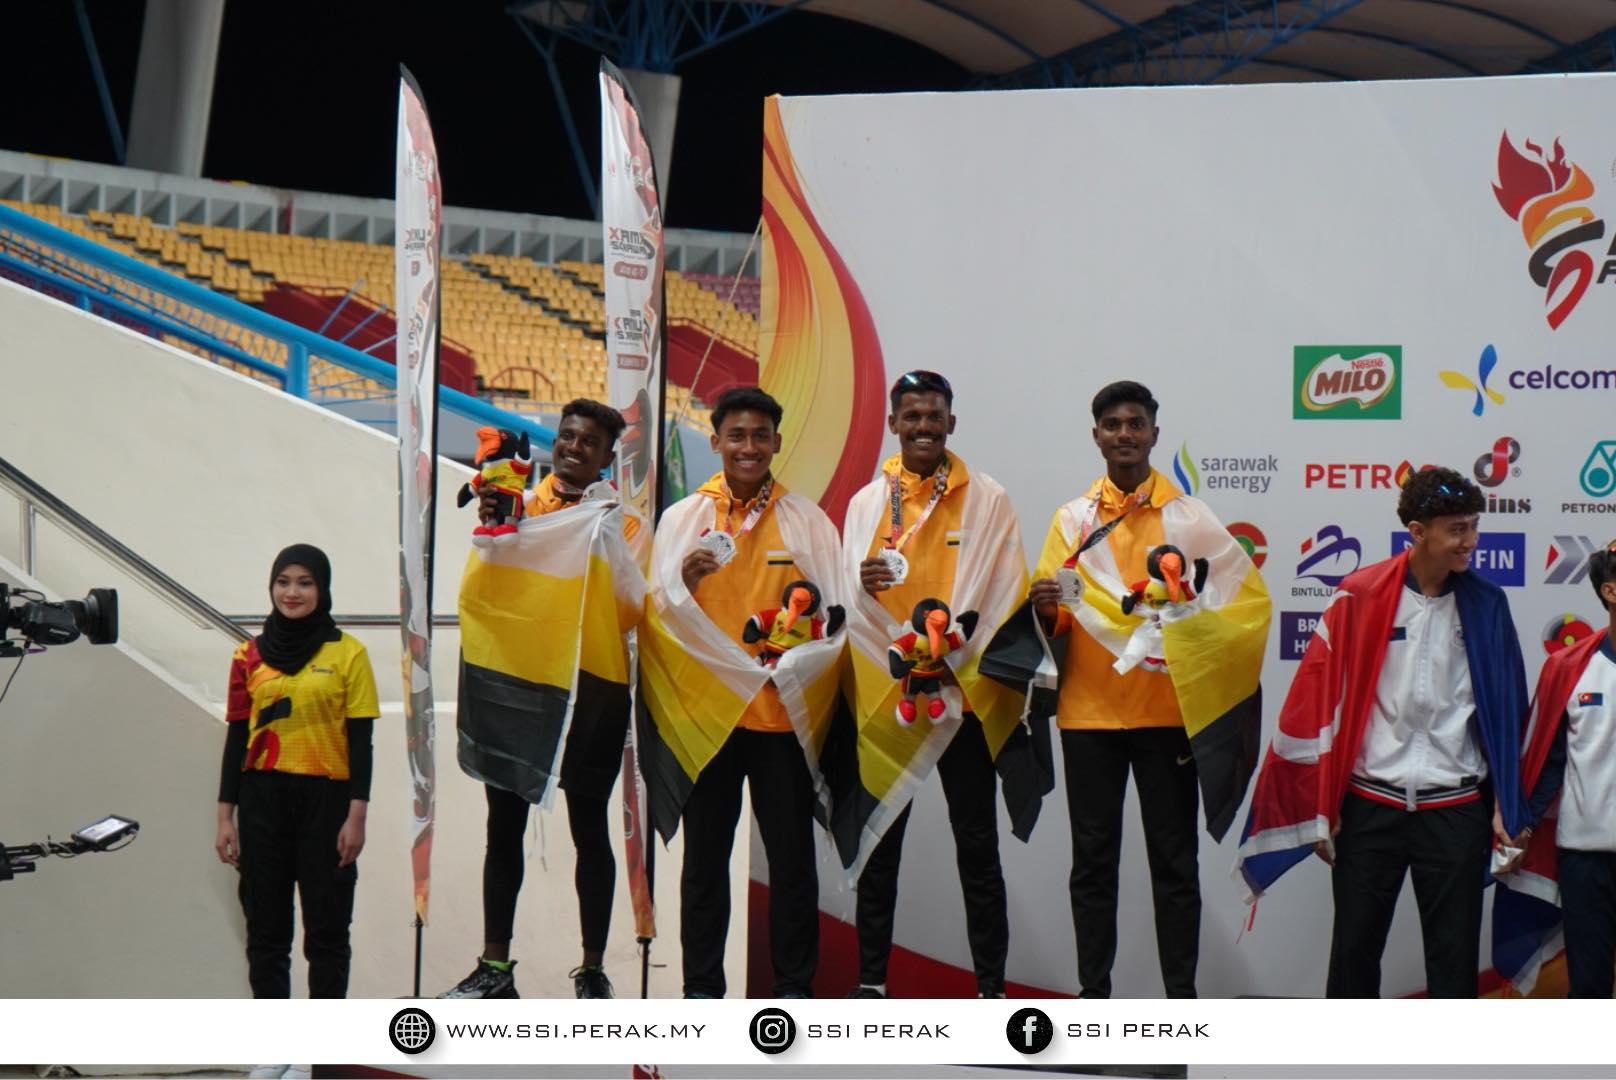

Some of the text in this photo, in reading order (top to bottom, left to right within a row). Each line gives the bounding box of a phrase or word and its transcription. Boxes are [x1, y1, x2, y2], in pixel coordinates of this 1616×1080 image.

[1314, 368, 1387, 397] MILO
[1508, 363, 1616, 390] celcom
[1201, 454, 1278, 472] sarawak
[1207, 475, 1271, 494] energy
[1468, 550, 1515, 569] FIN
[1291, 587, 1333, 597] BINTULU
